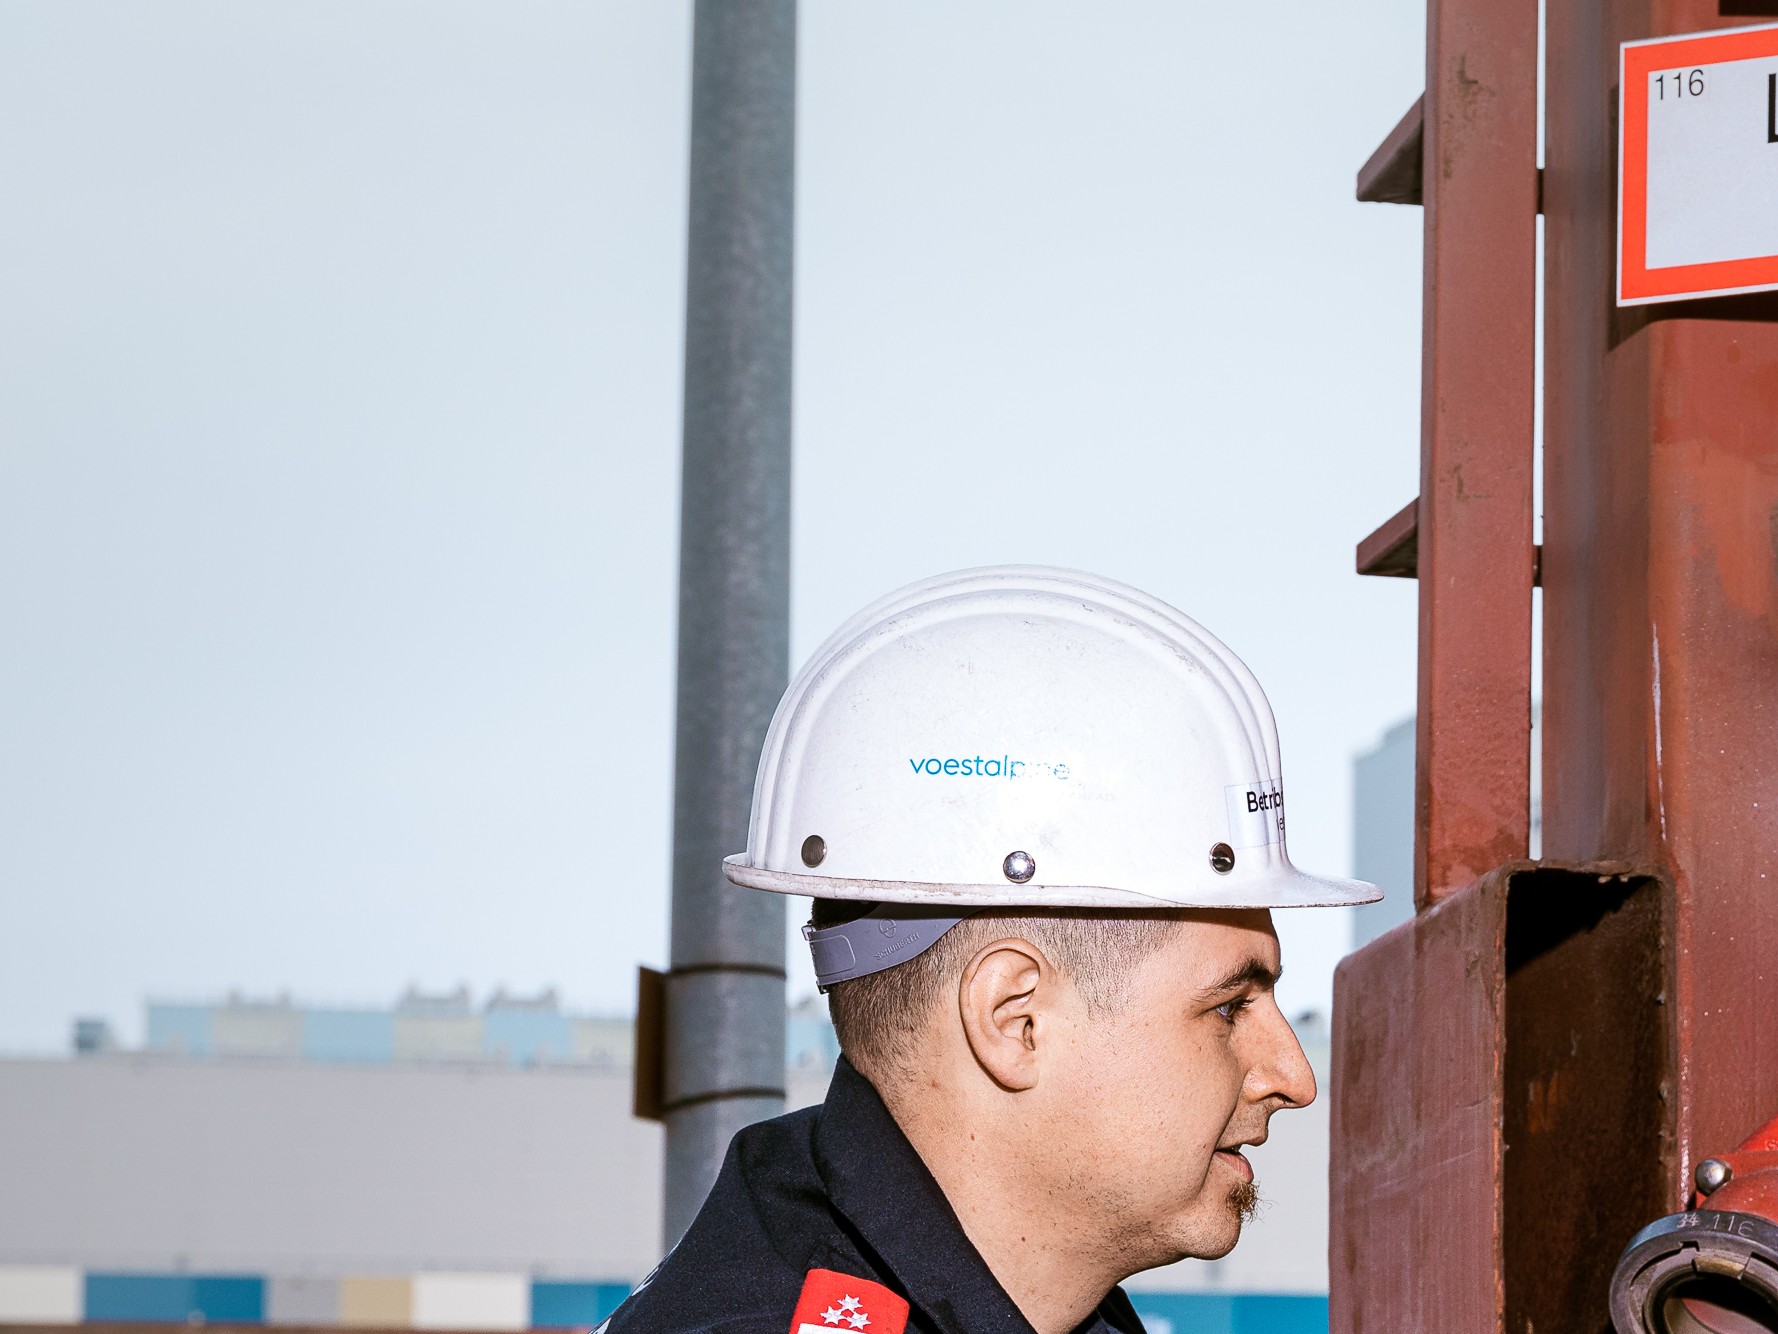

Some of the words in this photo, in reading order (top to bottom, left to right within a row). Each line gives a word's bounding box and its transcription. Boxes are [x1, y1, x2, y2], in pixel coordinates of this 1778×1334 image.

[1654, 69, 1706, 101] 116
[909, 755, 1071, 781] voestalpe
[1712, 1213, 1755, 1238] 116
